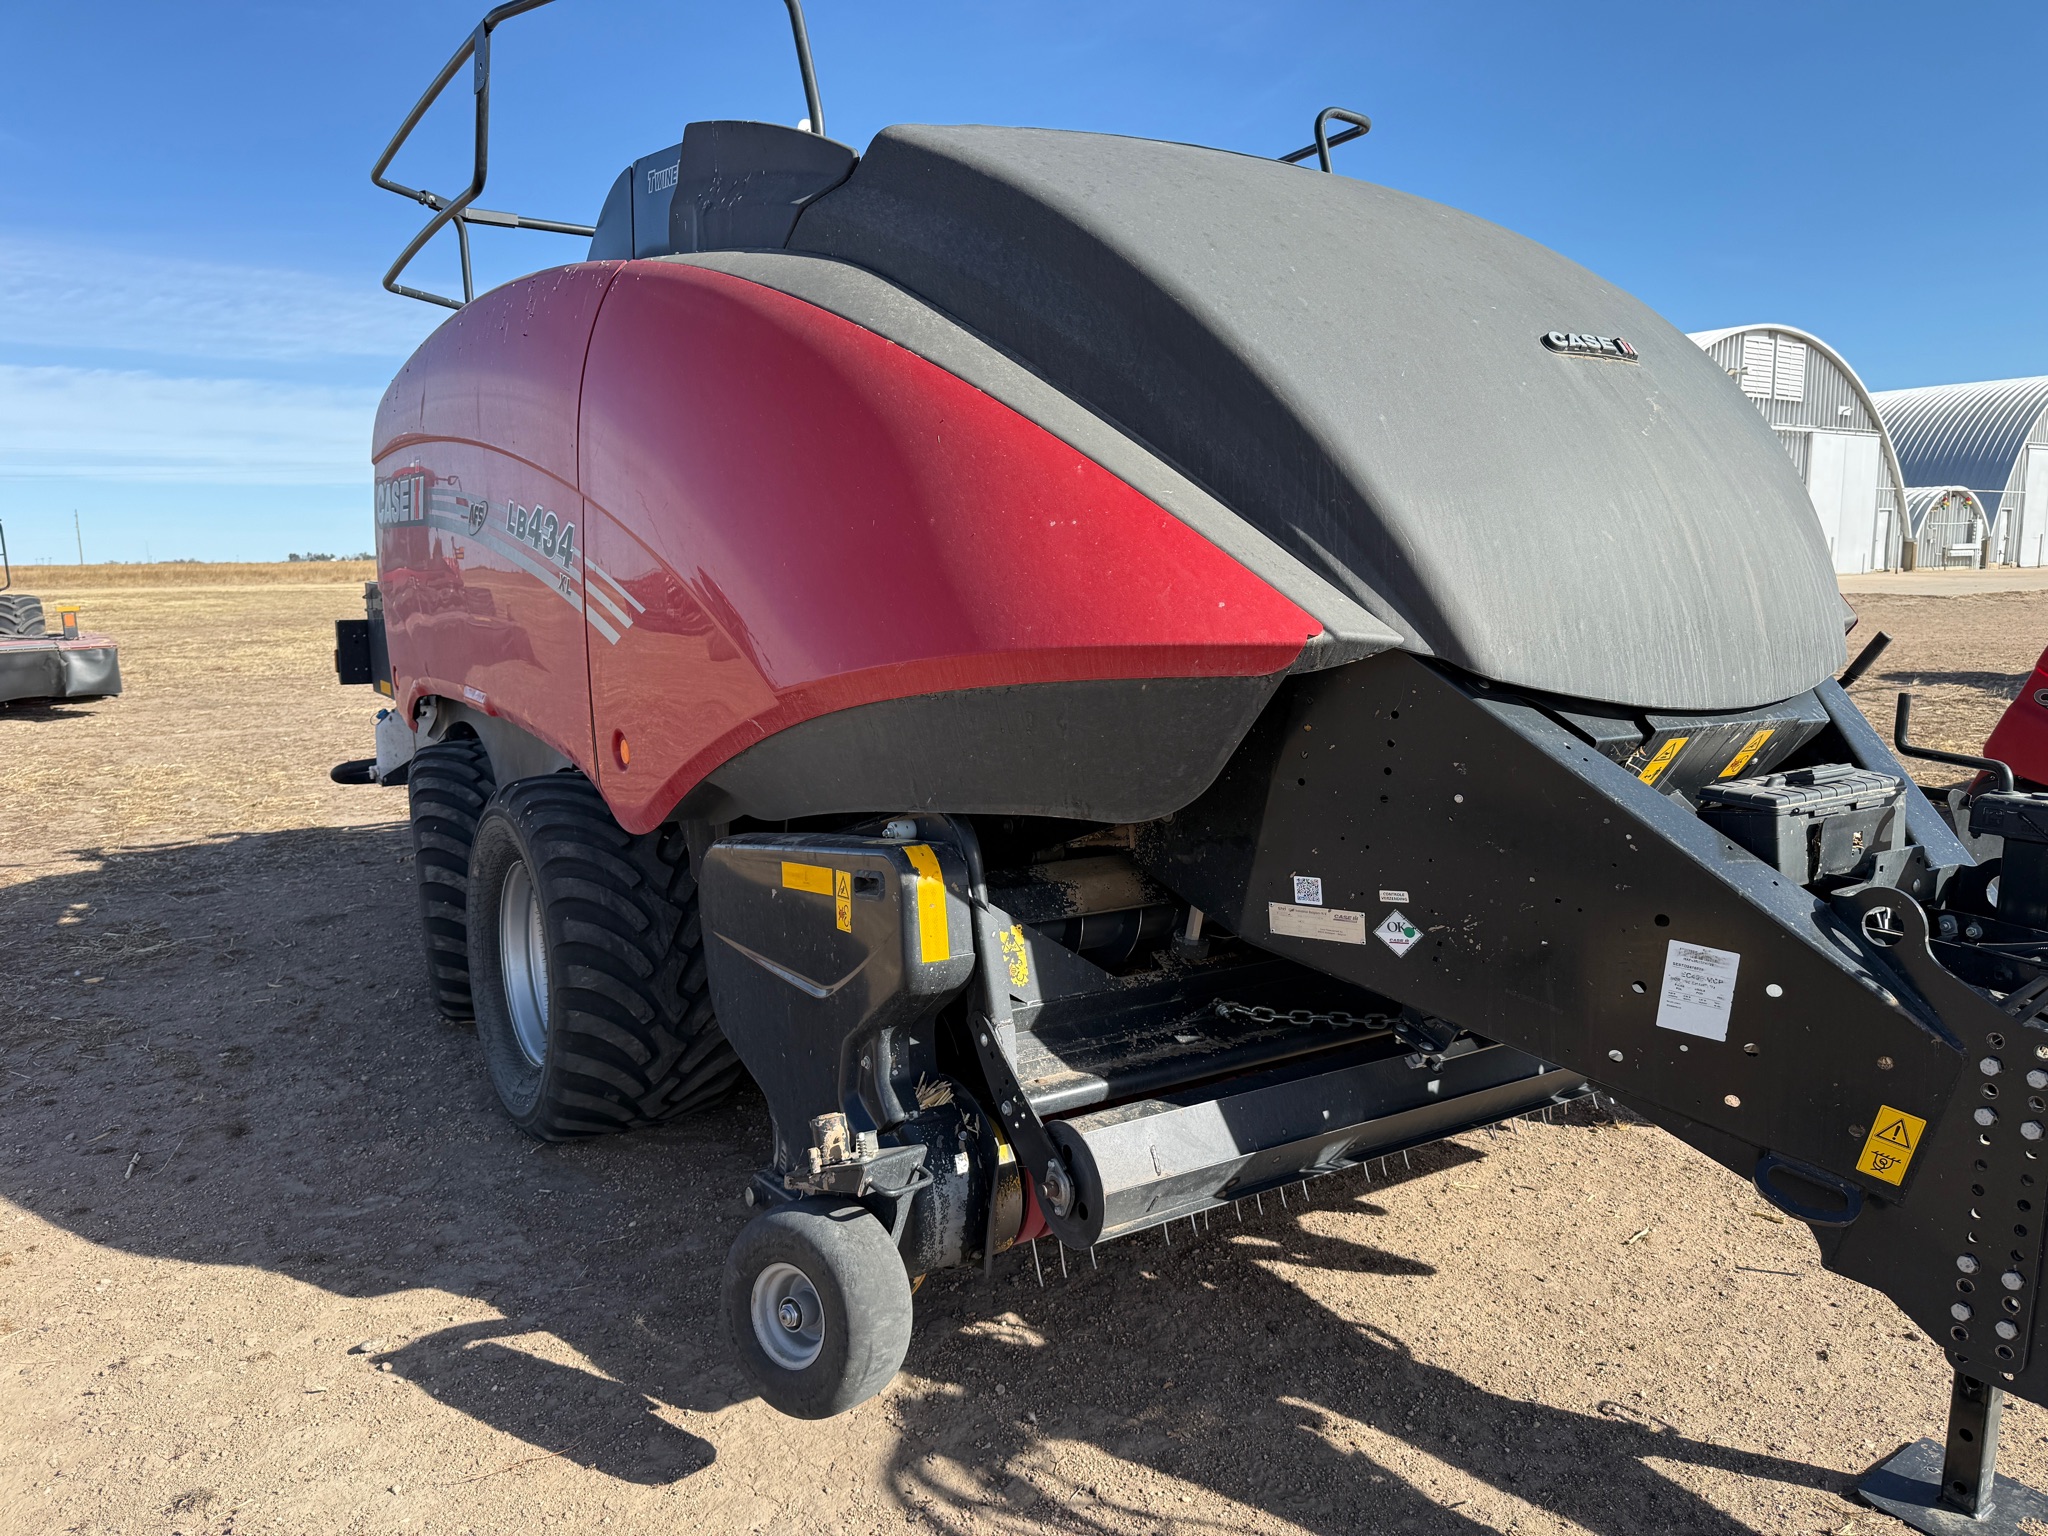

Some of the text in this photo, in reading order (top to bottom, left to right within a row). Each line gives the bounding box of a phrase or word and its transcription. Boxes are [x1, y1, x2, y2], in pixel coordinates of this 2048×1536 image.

[647, 159, 681, 194] TWINE
[506, 499, 575, 572] LB434
[558, 572, 572, 596] XL
[1387, 921, 1406, 933] OK
